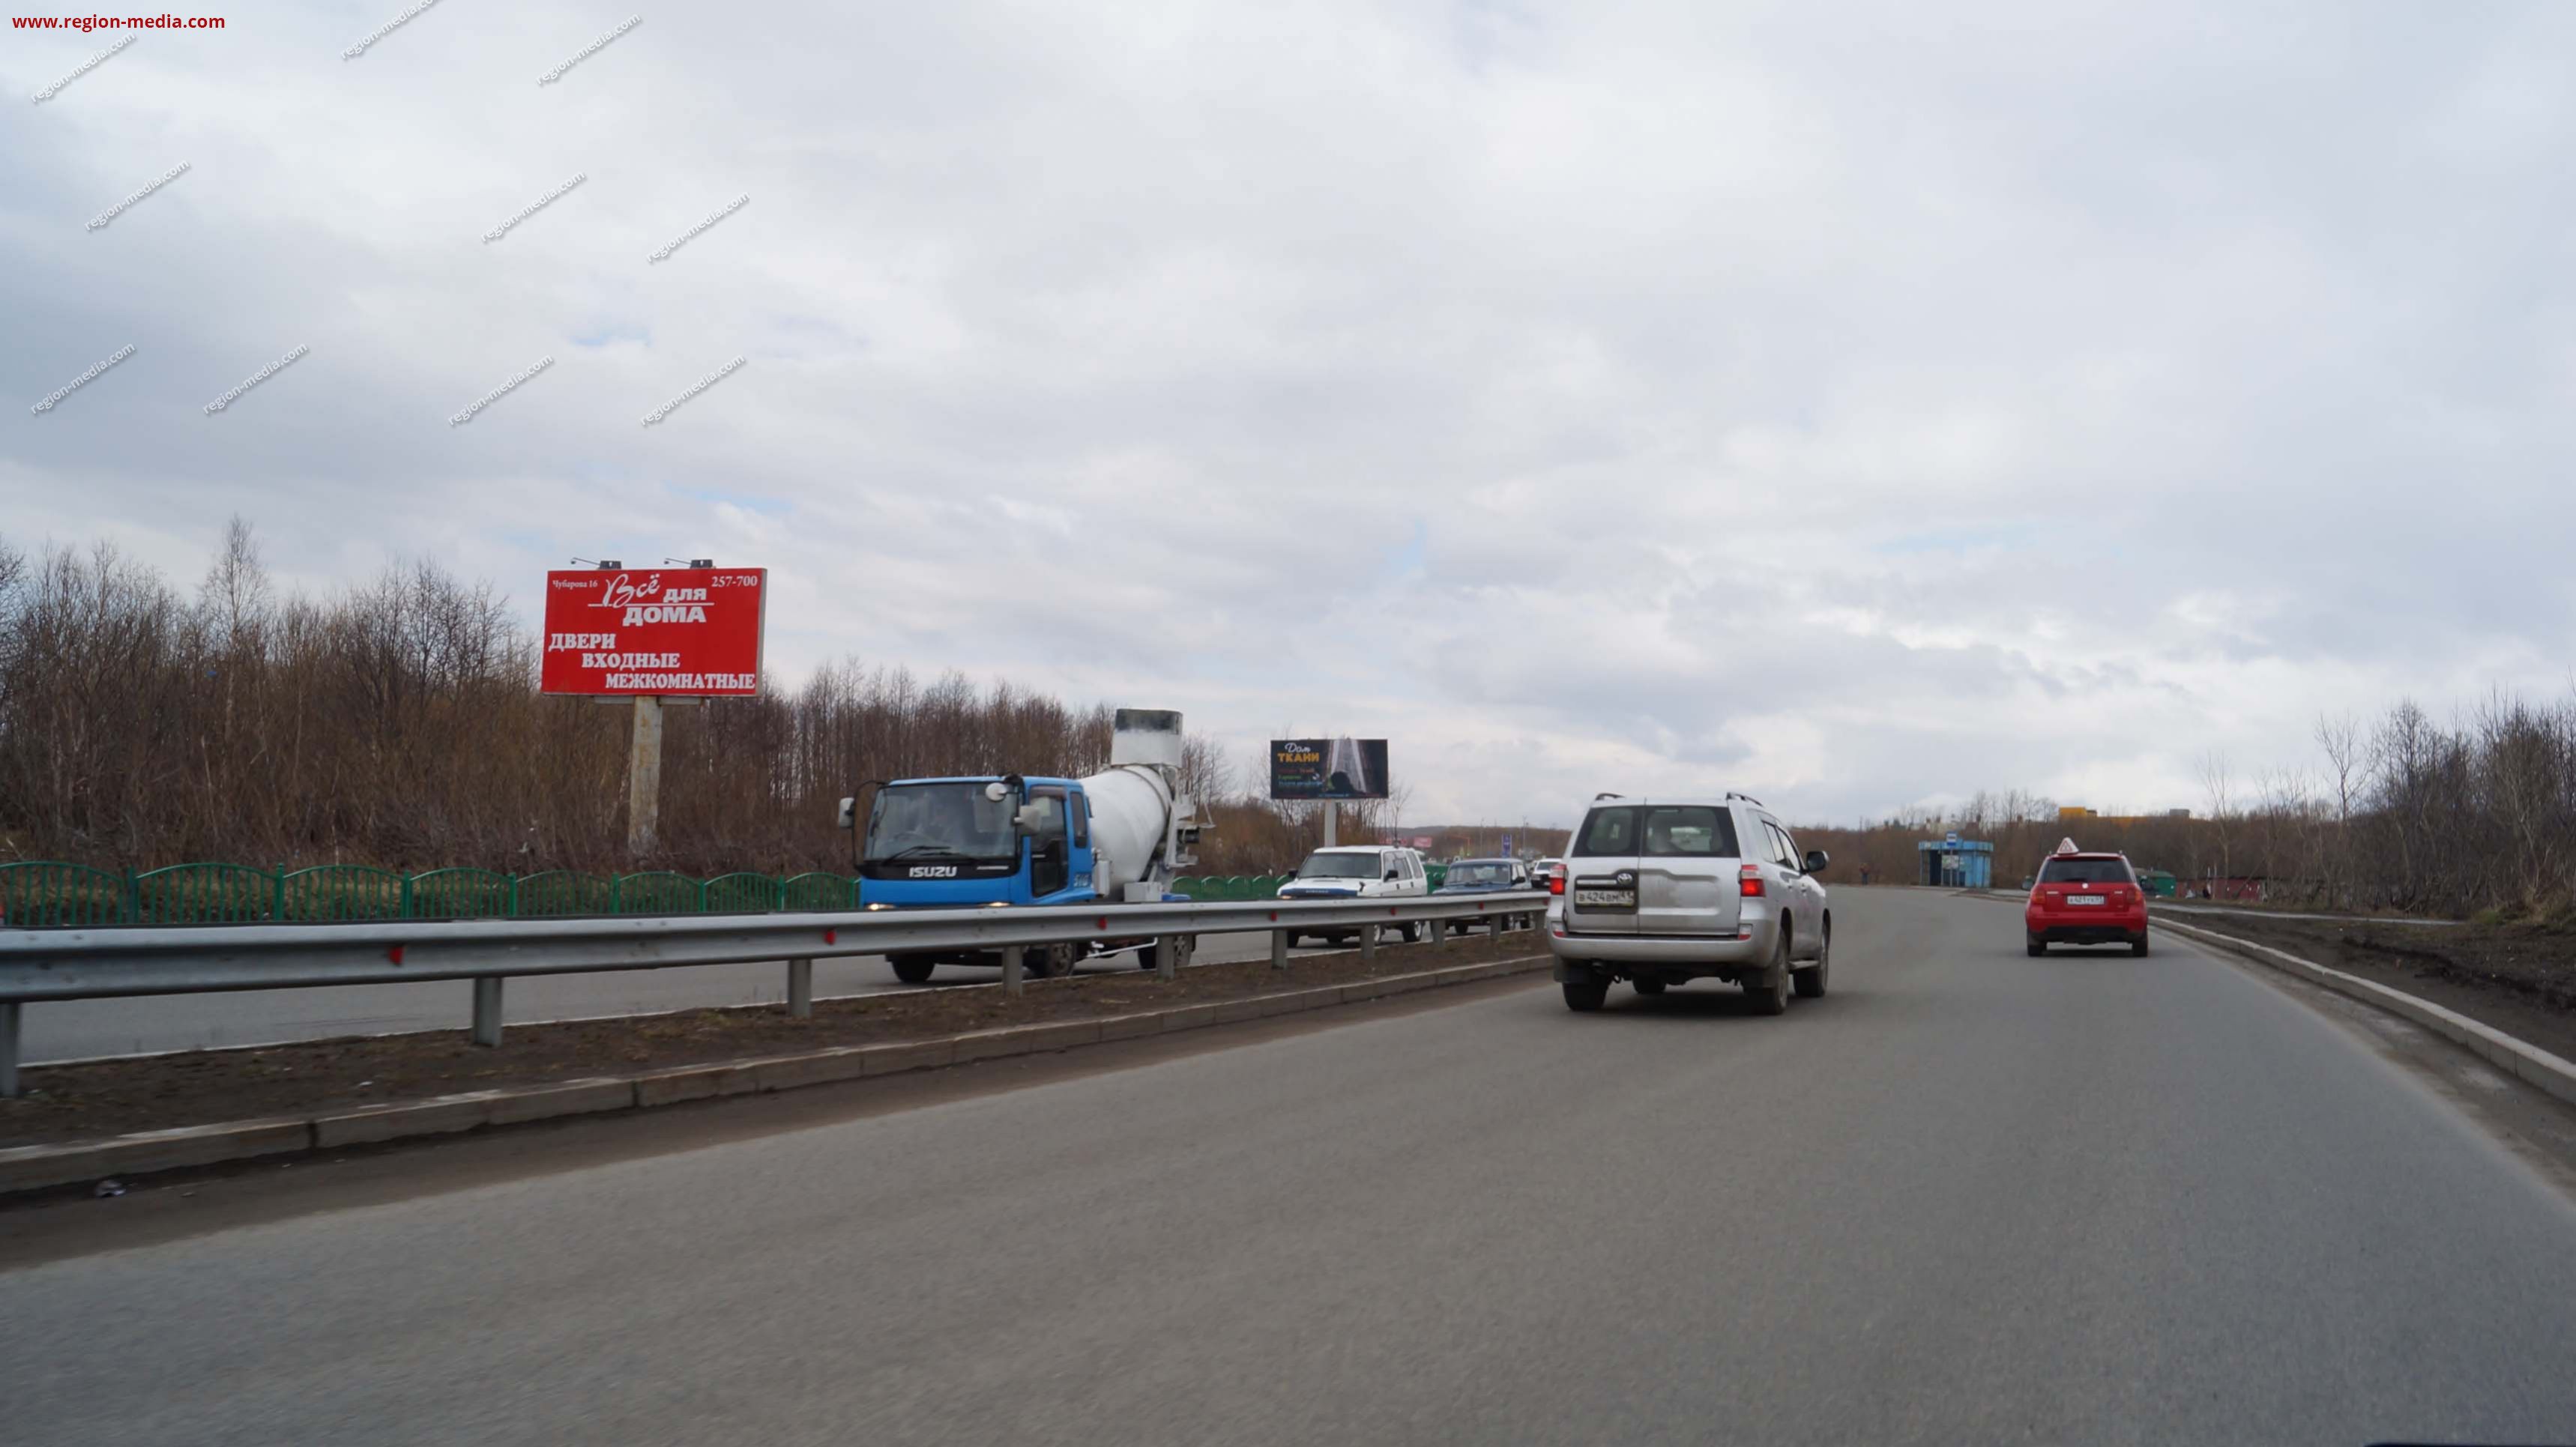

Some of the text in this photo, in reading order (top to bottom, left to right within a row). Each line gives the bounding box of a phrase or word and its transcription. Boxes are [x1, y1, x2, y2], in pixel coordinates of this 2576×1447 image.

[552, 579, 588, 590] Чубарова
[712, 576, 758, 587] 257-700
[602, 573, 660, 608] Всё
[622, 606, 706, 626] ДОМА
[548, 633, 616, 652] ДВЕРИ
[582, 653, 681, 671] ВХОДНЫЕ
[605, 673, 755, 689] МЕЖКОМНАТНЫЕ
[1285, 743, 1310, 752] Дом
[1277, 752, 1319, 763] ТКАНИ
[909, 866, 957, 877] ISUZU
